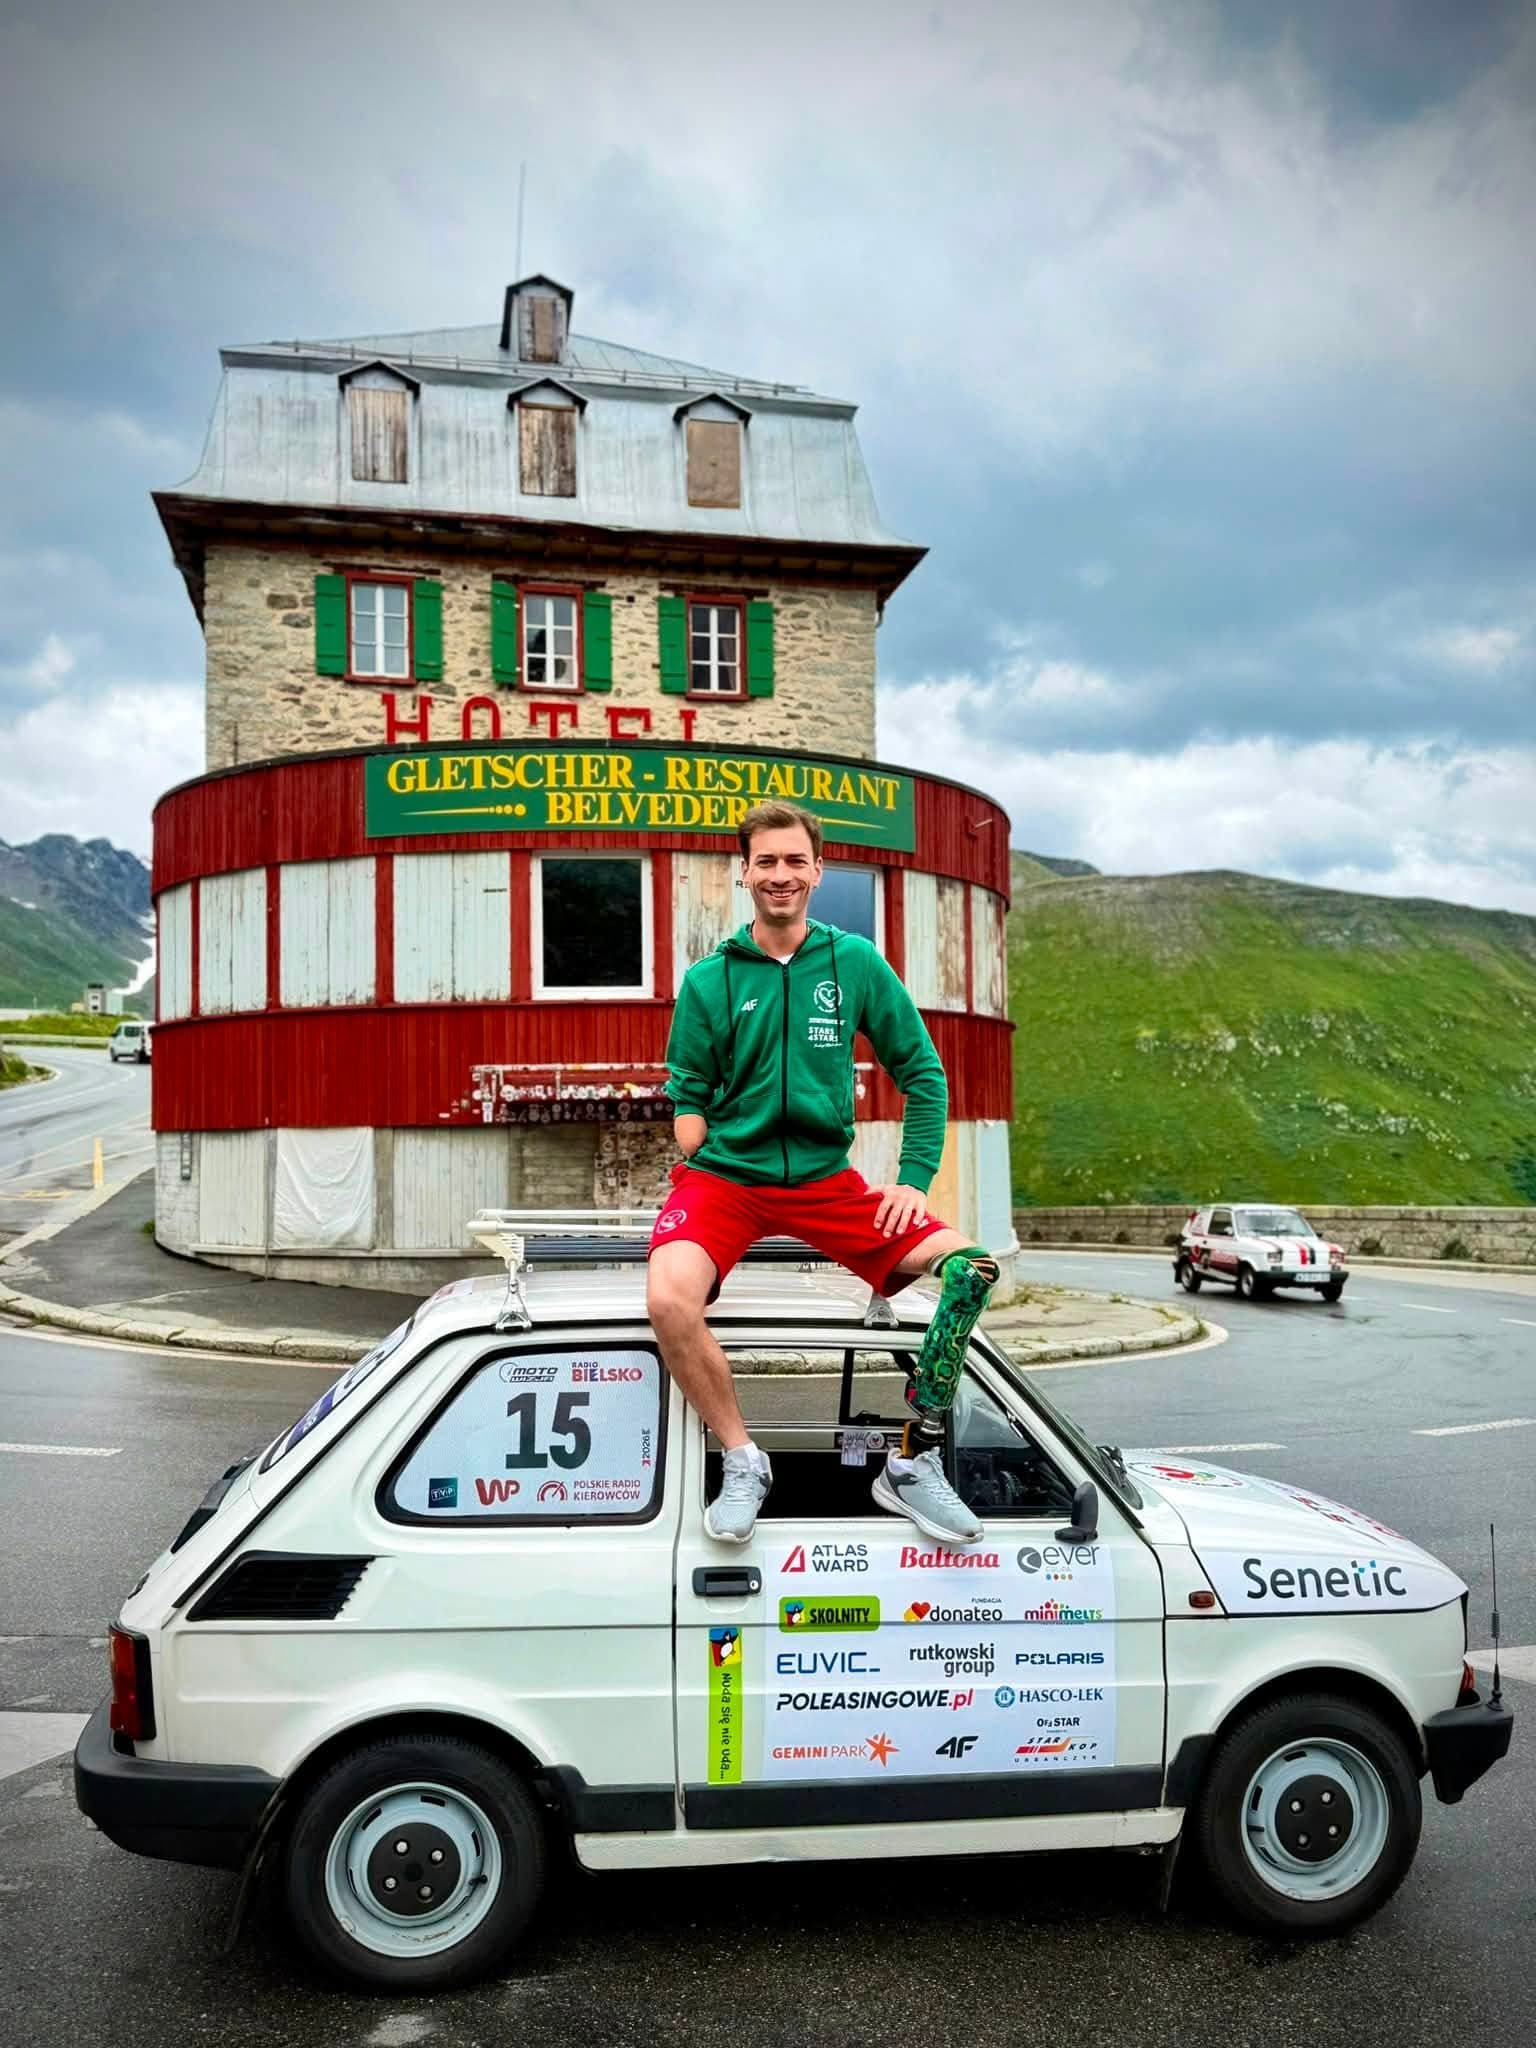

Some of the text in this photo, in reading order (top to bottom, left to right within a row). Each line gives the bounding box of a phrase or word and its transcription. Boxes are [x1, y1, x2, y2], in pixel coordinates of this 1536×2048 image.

[387, 753, 635, 794] GLETSCHER
[664, 756, 900, 811] RESTAURANT
[512, 1367, 559, 1376] MOTO
[571, 1361, 599, 1369] RADIO
[571, 1368, 643, 1383] BIELSKO
[505, 1391, 592, 1470] 15
[475, 1478, 521, 1506] WP
[573, 1479, 641, 1489] POLSKIE RADIO
[573, 1489, 641, 1501] KIEROWCÓW
[811, 1544, 868, 1557] ATLAS
[899, 1546, 1001, 1569] Baltona
[1043, 1546, 1100, 1566] ever
[811, 1559, 869, 1573] WARD
[1242, 1557, 1407, 1600] Senetic
[809, 1607, 870, 1625] SKOLNITY
[929, 1605, 1003, 1622] donateo
[909, 1643, 995, 1661] rutkowski
[1015, 1652, 1104, 1666] POLARIS
[944, 1660, 995, 1678] group
[776, 1688, 974, 1711] POLEASINGOWE.pl
[1019, 1687, 1104, 1703] HASCO-LEK
[720, 1728, 733, 1745] nie
[772, 1744, 867, 1759] GEMINI PARK
[935, 1735, 979, 1759] 4F
